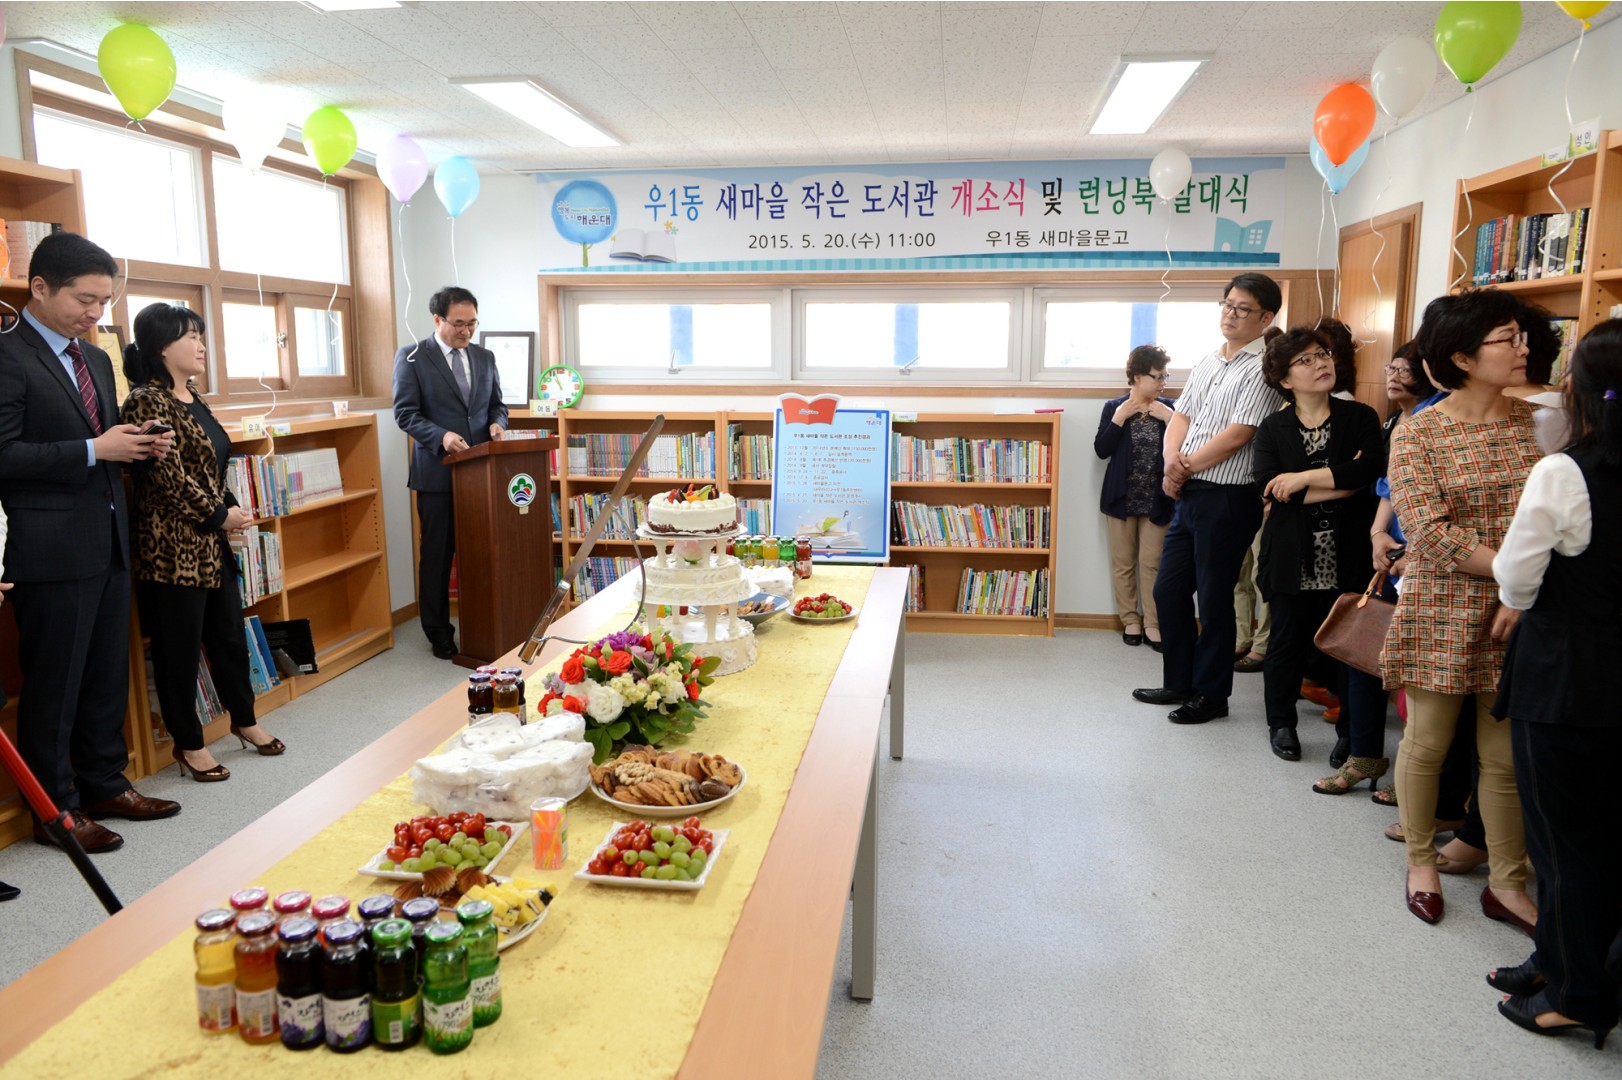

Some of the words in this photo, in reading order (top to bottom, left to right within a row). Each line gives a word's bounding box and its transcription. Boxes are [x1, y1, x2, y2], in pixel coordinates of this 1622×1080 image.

[644, 184, 703, 222] 우1동
[715, 181, 789, 221] 새마을
[801, 181, 850, 219] 작은
[861, 180, 938, 218] 도서관
[950, 178, 1026, 217] 개소식
[1040, 177, 1063, 216] 및
[1077, 176, 1157, 215] 런닝북
[748, 234, 794, 249] 2015.
[801, 234, 816, 249] 5.
[824, 232, 881, 249] 20.(수)
[888, 232, 936, 247] 11:00
[985, 230, 1031, 248] 우1동
[1039, 229, 1129, 247] 새마을문고
